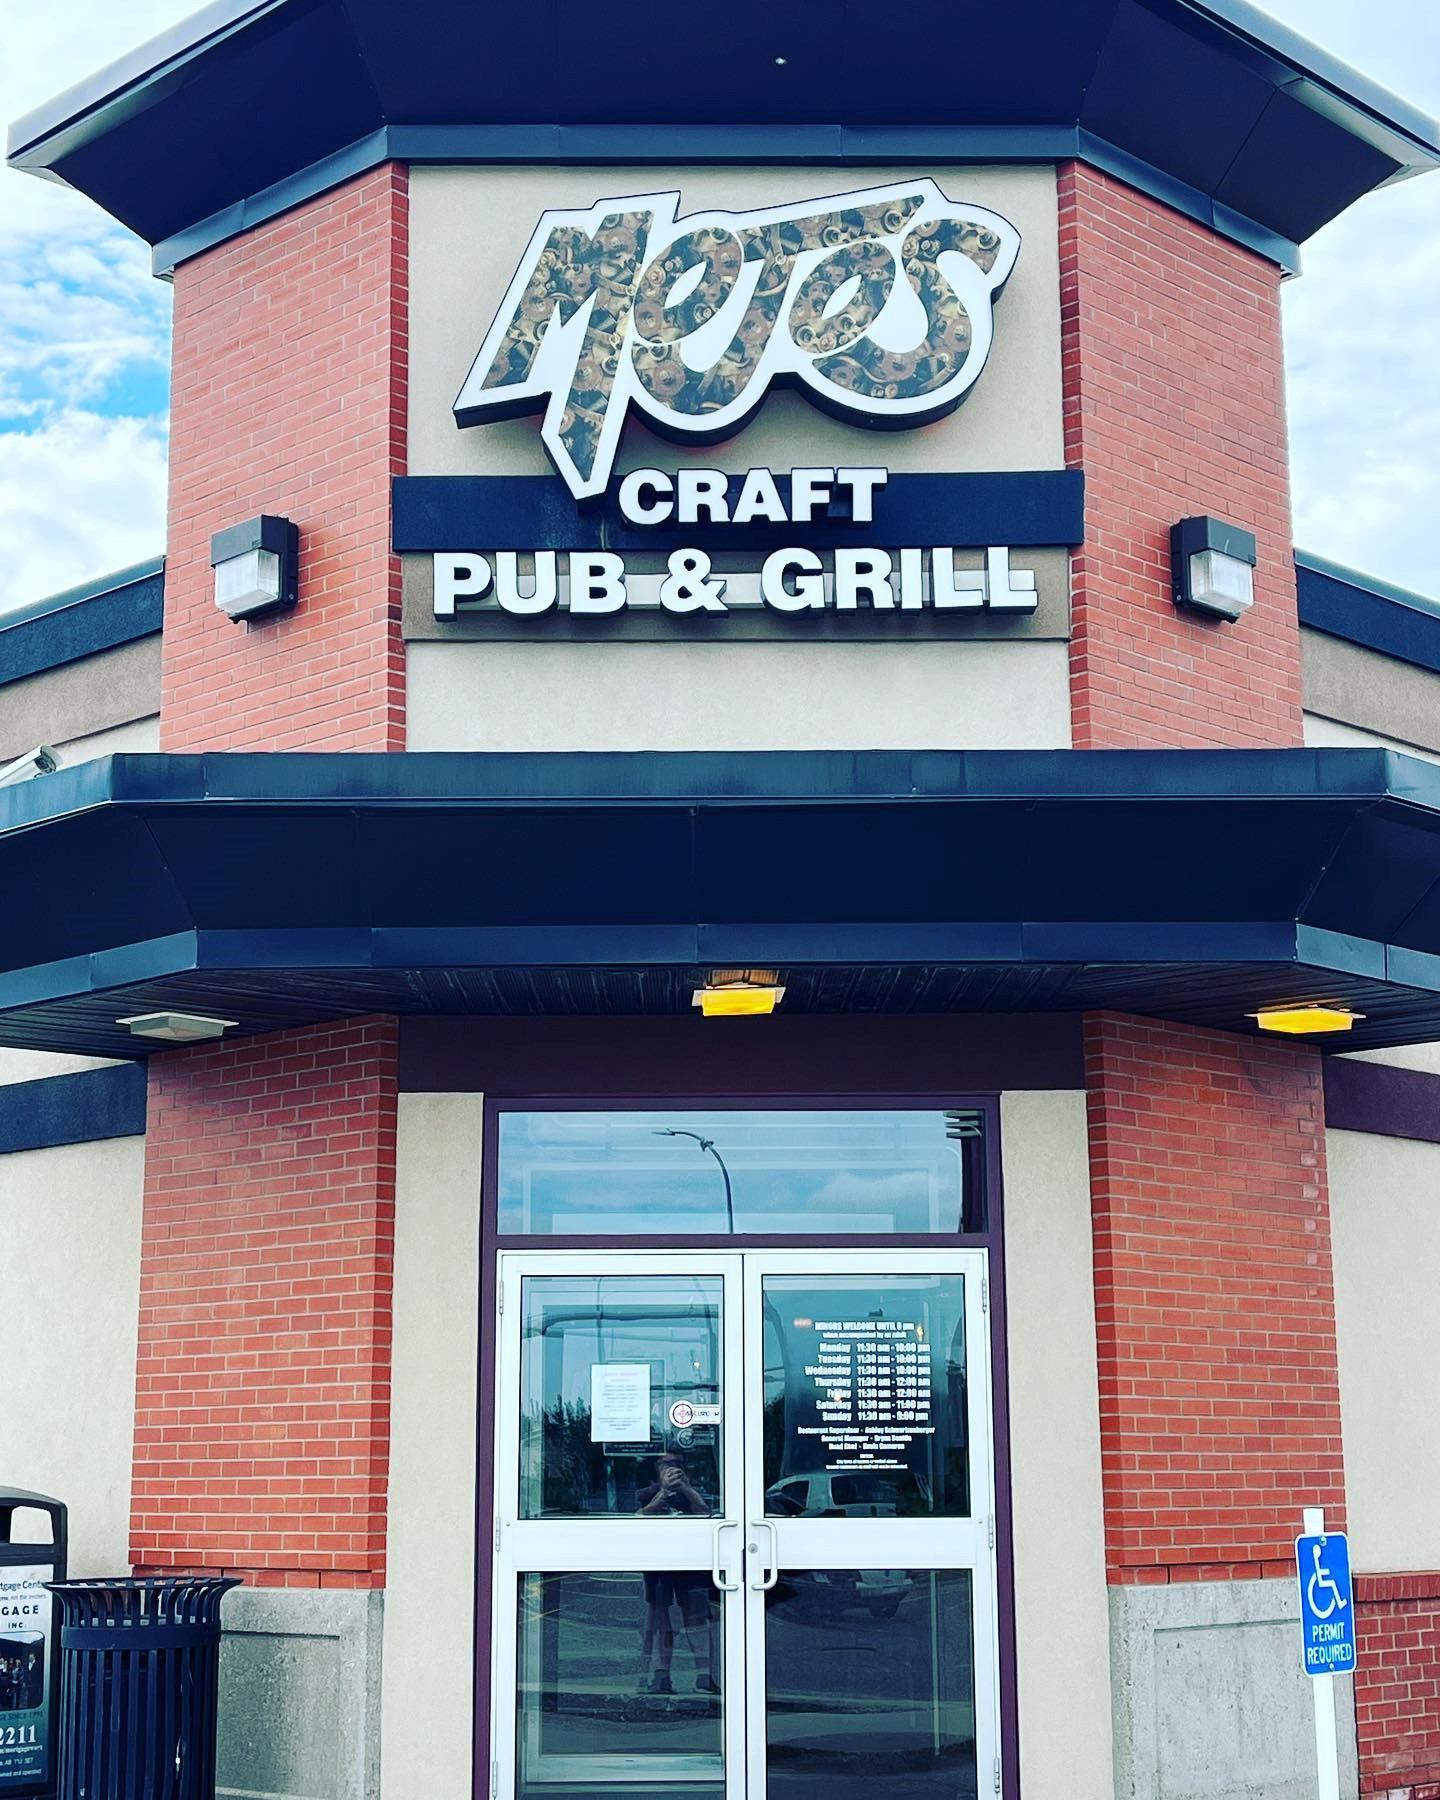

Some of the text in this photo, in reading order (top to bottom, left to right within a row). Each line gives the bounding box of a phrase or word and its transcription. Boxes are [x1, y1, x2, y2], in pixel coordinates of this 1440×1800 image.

[619, 467, 887, 525] CRAFT
[433, 547, 1037, 618] PUB & GRILL
[843, 1322, 876, 1331] WELCOME
[877, 1322, 896, 1331] UNTIL
[820, 1343, 851, 1353] Monday
[818, 1354, 851, 1364] Tuesday
[805, 1365, 851, 1375] Wednesday
[815, 1377, 851, 1387] Thursday
[827, 1388, 851, 1398] Friday
[816, 1400, 851, 1410] Saturday
[823, 1411, 851, 1421] Sunday
[1, 1604, 39, 1616] GAGE
[1312, 1622, 1344, 1642] PERMIT
[1307, 1643, 1352, 1665] REQUIRED
